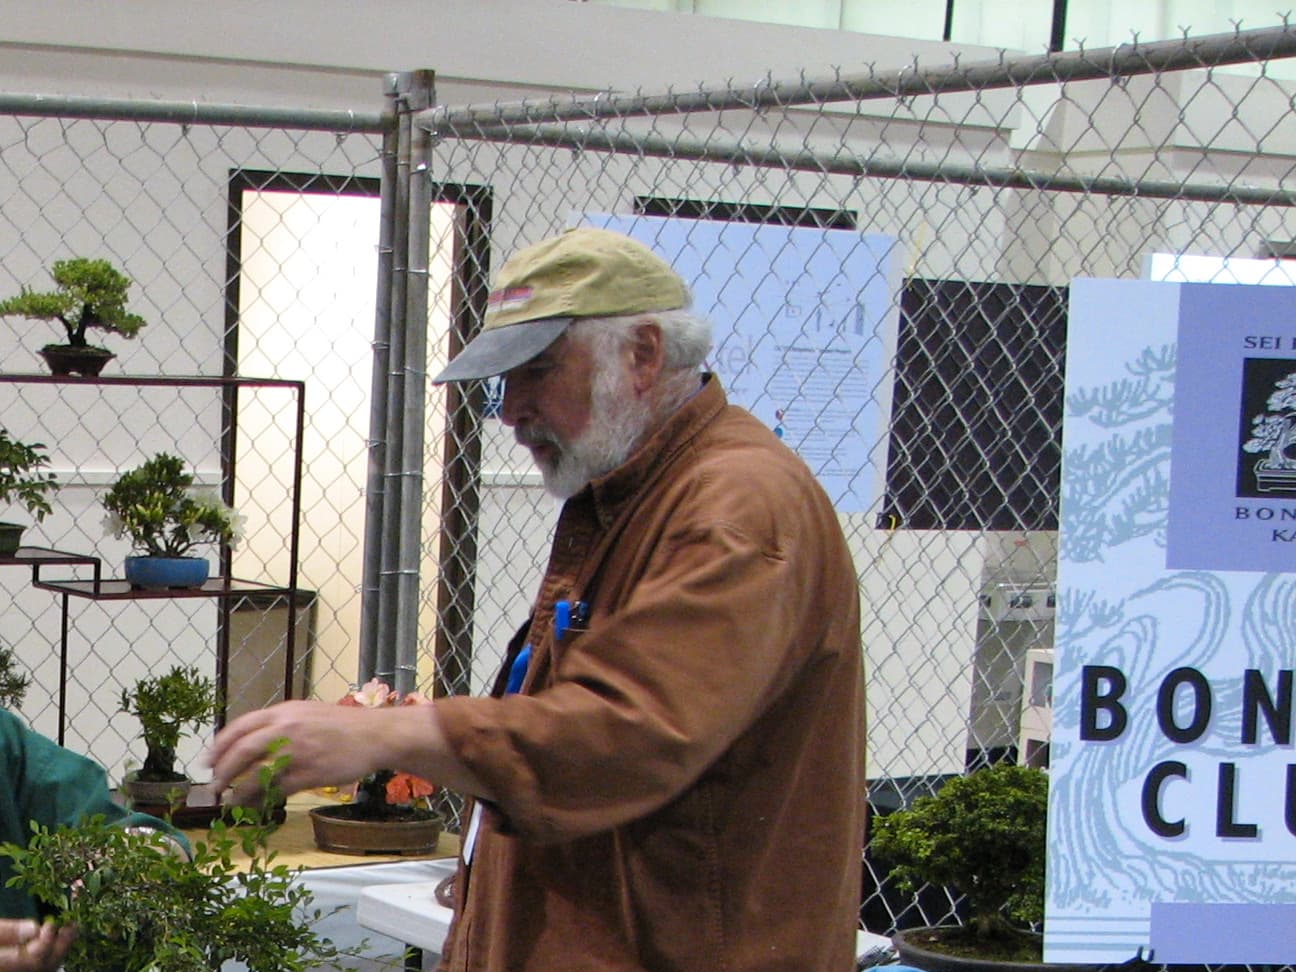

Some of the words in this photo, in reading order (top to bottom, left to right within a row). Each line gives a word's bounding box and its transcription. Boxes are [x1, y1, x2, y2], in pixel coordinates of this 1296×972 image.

[1244, 336, 1281, 350] SEI
[1235, 507, 1296, 521] BON
[1080, 665, 1294, 746] BON
[1141, 760, 1296, 838] CL
